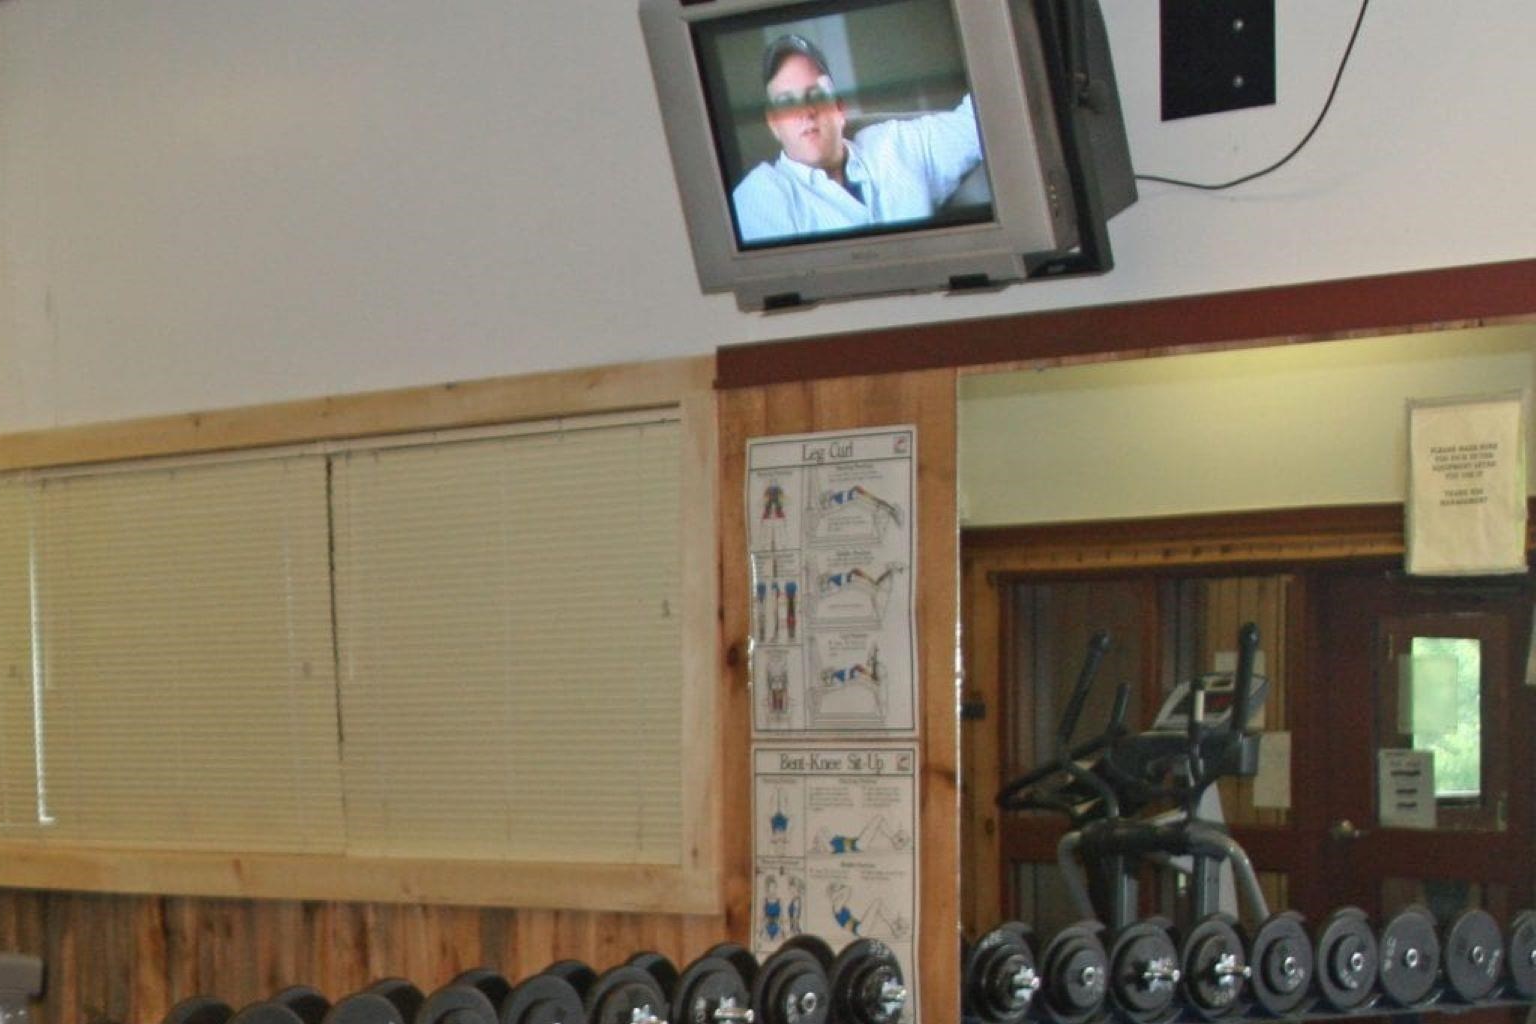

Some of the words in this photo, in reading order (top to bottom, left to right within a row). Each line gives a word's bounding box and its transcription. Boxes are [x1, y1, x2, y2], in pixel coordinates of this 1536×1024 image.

[802, 443, 825, 465] Leg
[830, 441, 853, 459] Curl
[779, 753, 842, 770] Bent-Knee
[847, 752, 884, 775] Sit-Up
